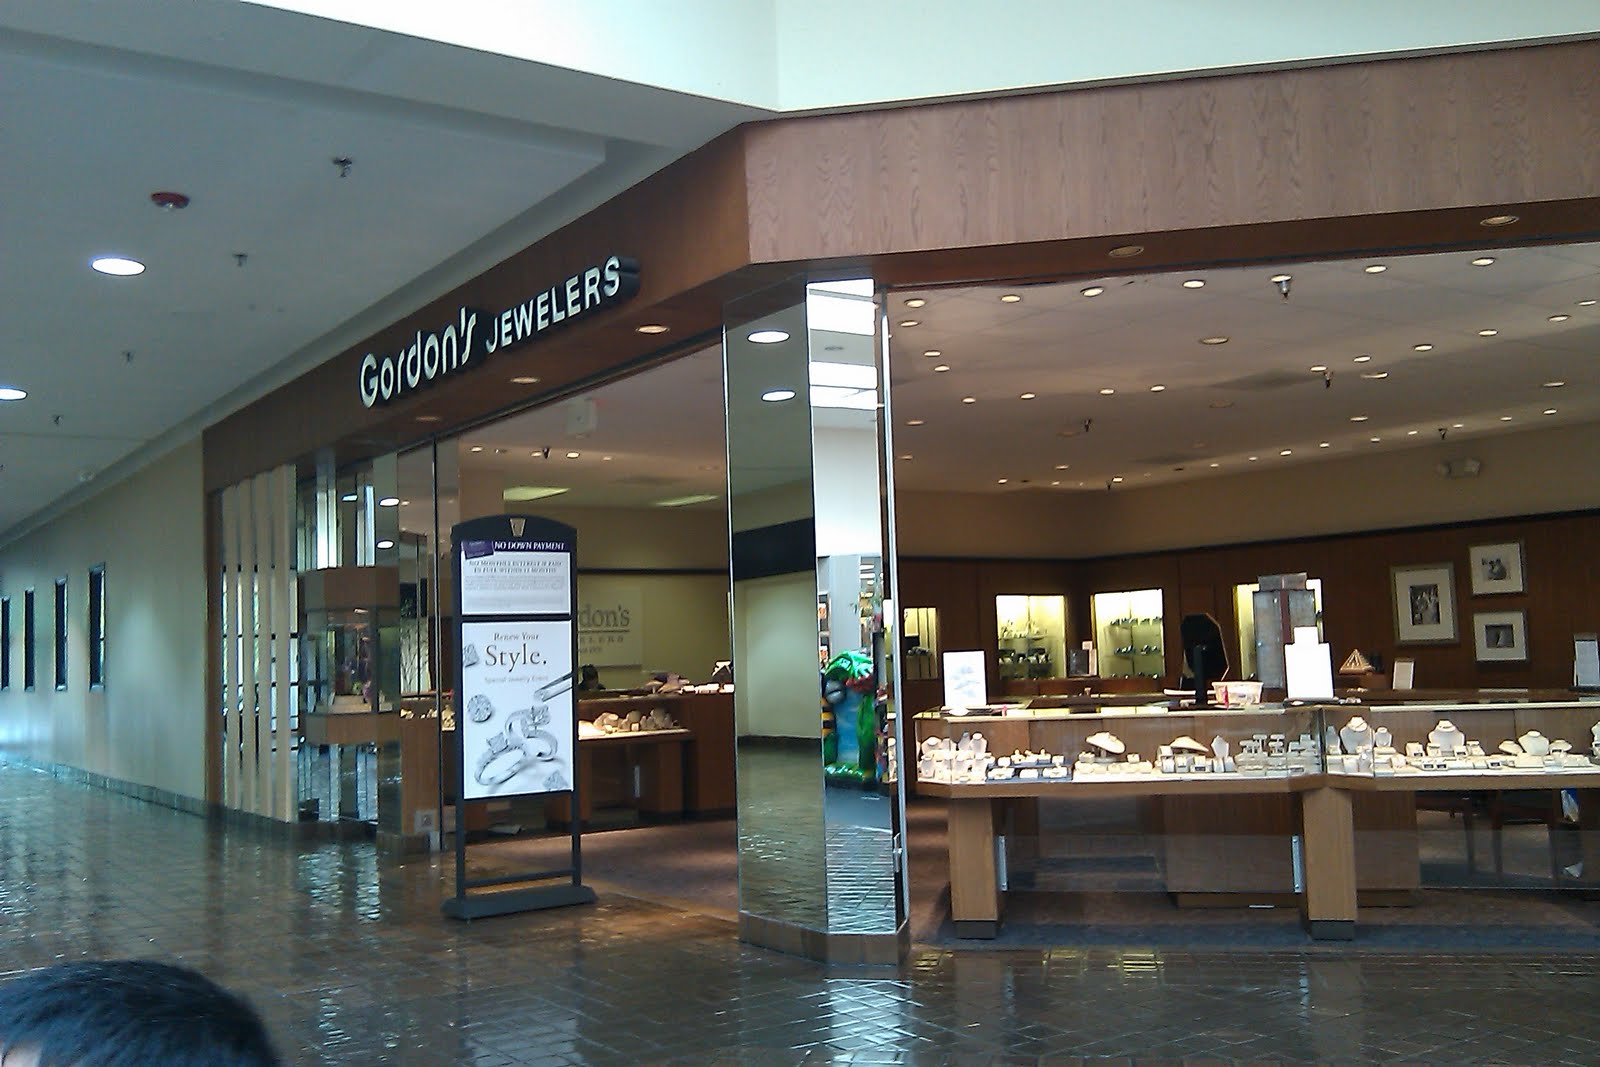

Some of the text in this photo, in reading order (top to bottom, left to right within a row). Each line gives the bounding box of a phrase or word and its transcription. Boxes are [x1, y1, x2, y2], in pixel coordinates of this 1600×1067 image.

[359, 255, 621, 409] Gordon's JEWELERS
[494, 541, 507, 550] NO
[508, 541, 532, 550] DOWN
[533, 541, 565, 551] PAYMENT
[578, 604, 630, 627] don's
[494, 631, 539, 641] Renew Your
[484, 643, 547, 673] Style.
